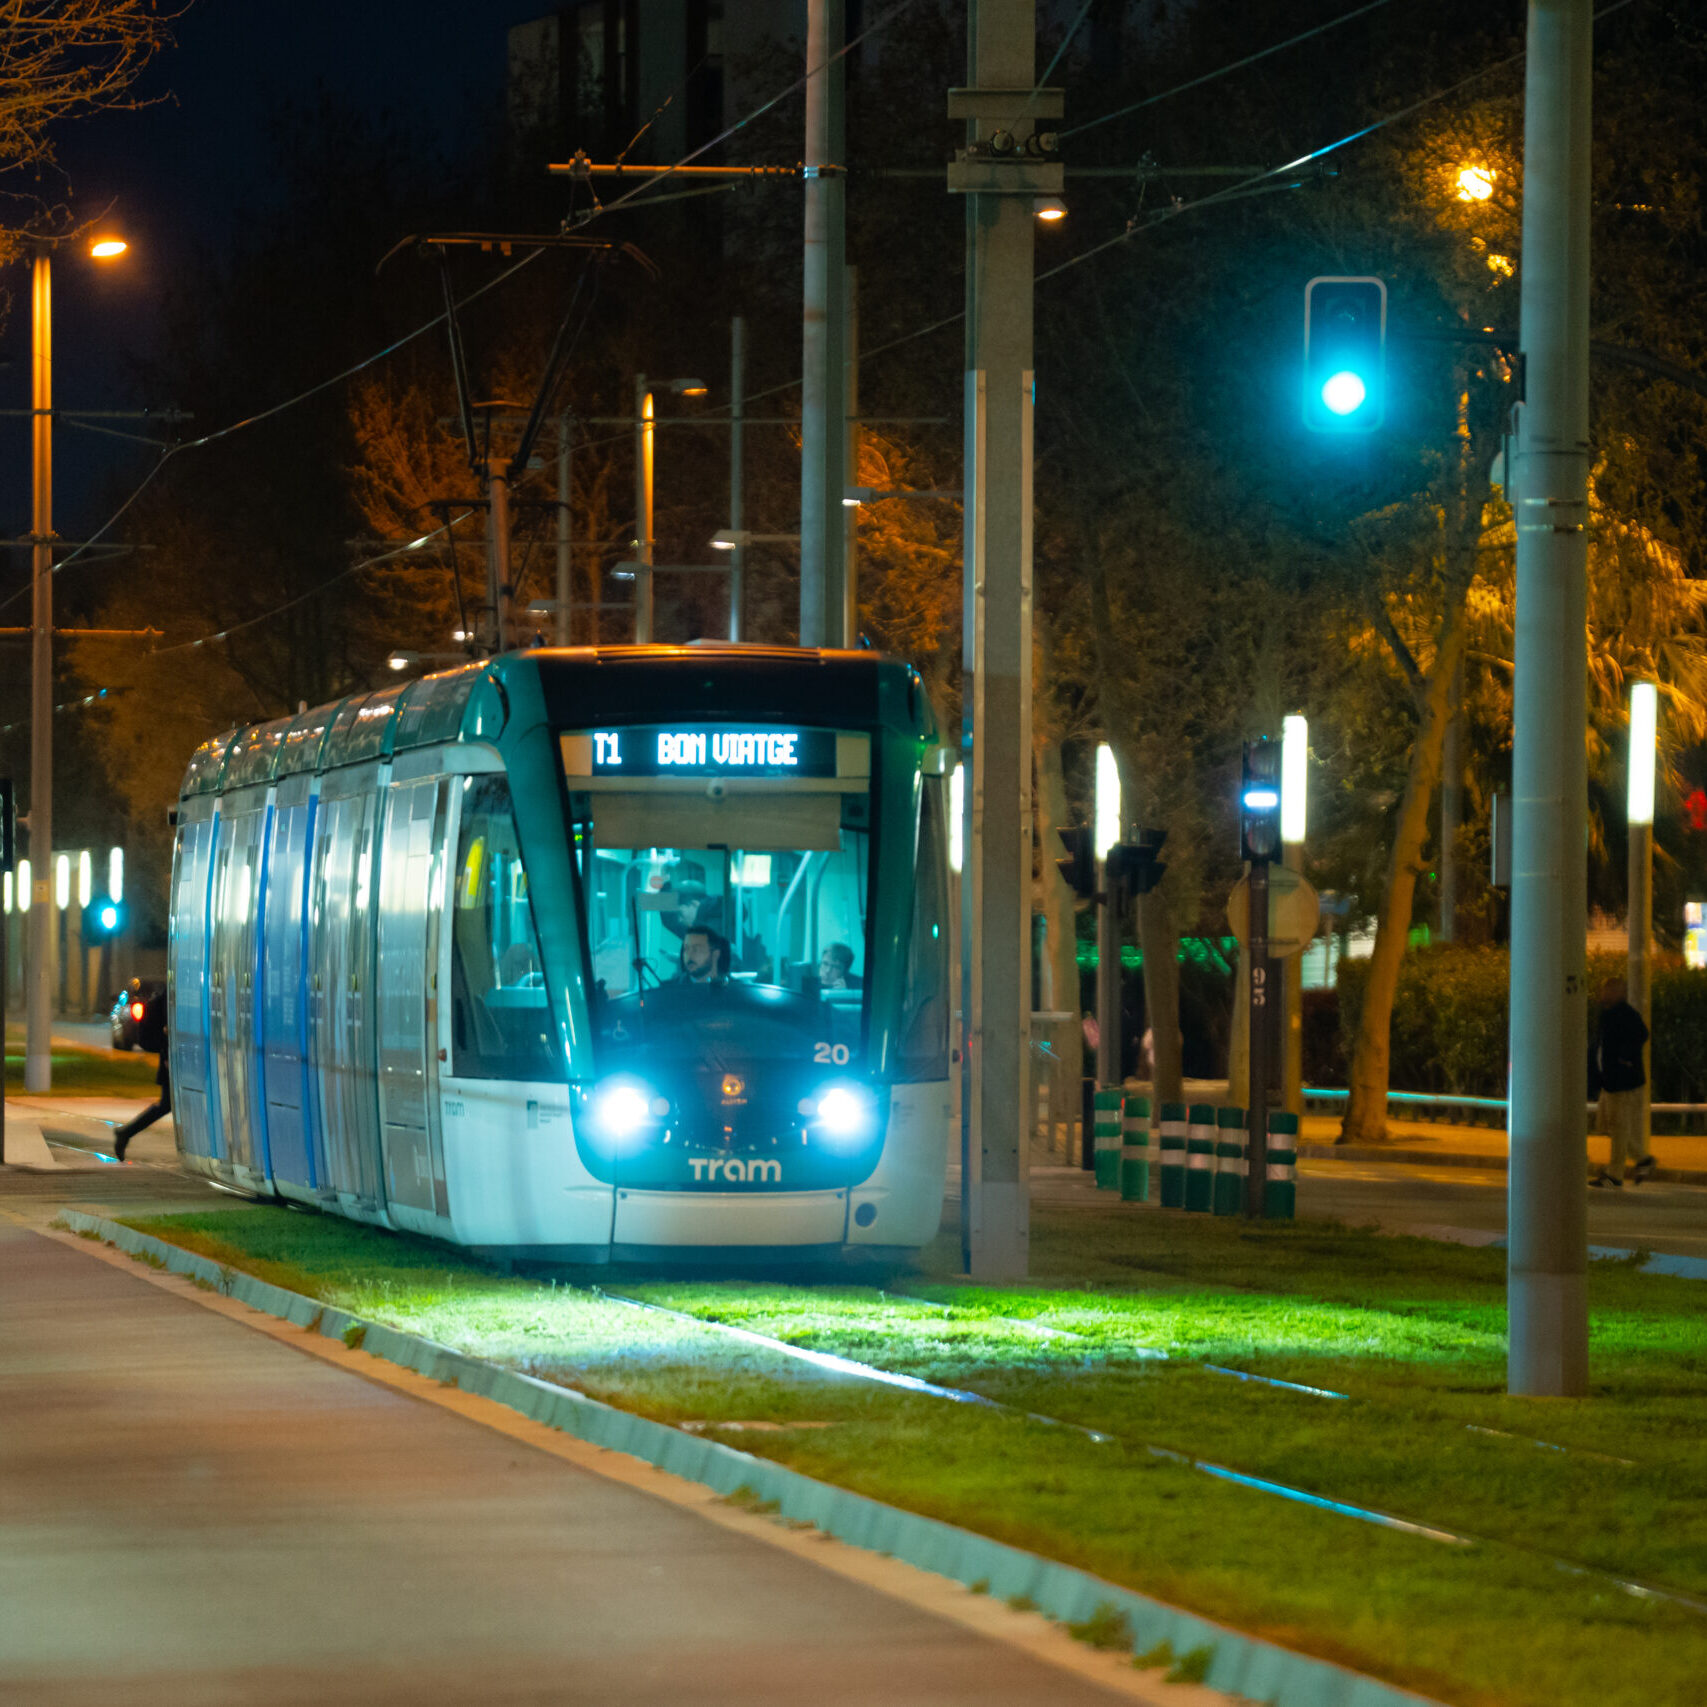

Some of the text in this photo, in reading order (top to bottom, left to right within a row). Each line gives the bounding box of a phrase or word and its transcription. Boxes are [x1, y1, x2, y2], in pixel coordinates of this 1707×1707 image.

[594, 732, 798, 765] T1 BON VIATGE
[813, 1042, 849, 1066] 20
